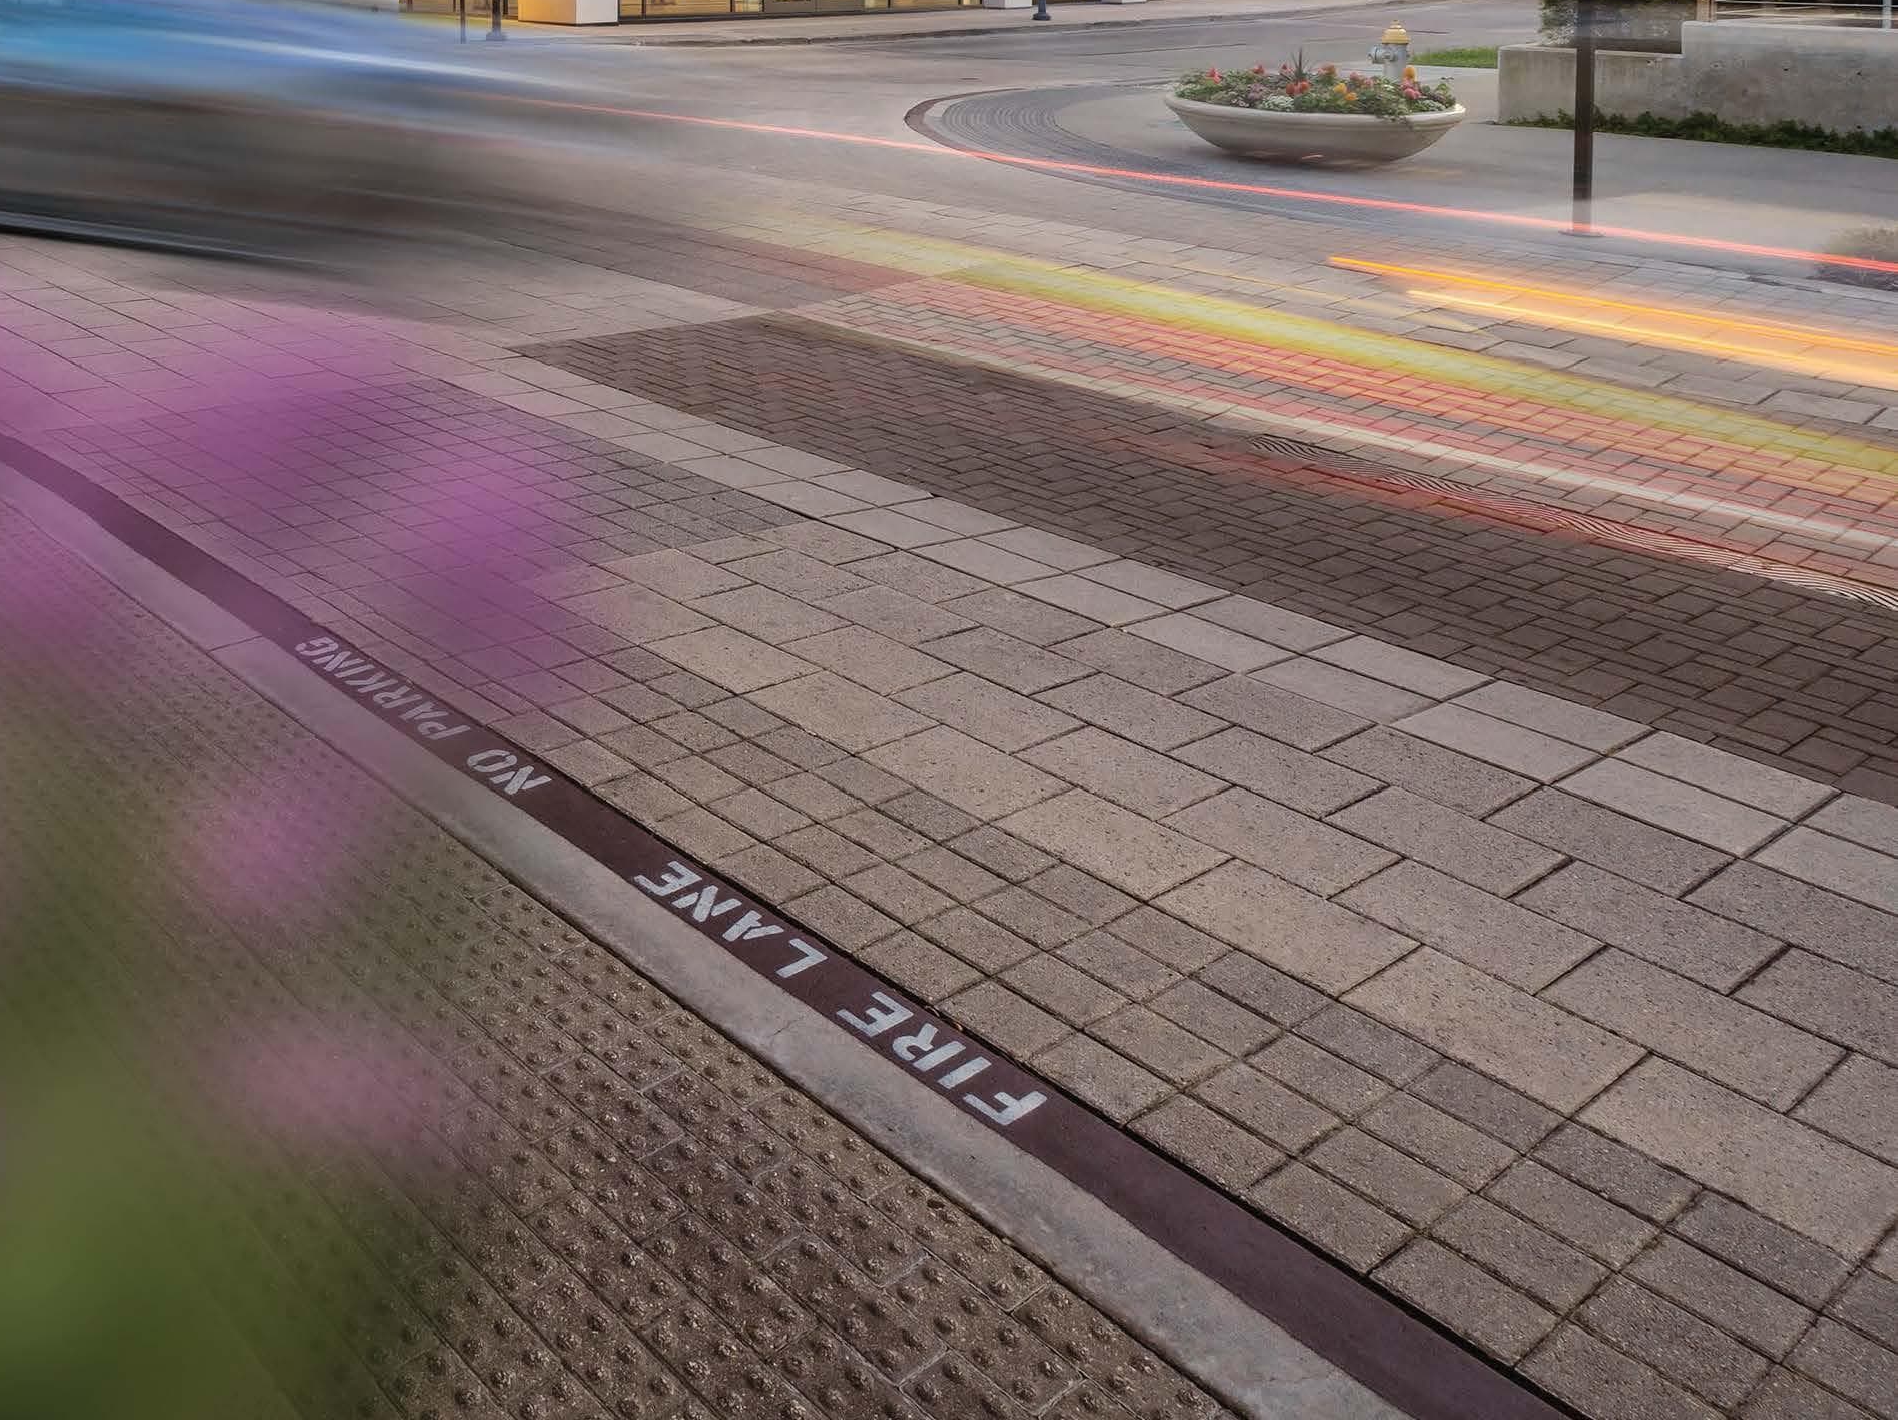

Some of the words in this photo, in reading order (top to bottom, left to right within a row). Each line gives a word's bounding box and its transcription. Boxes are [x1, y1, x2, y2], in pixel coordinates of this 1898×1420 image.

[295, 636, 471, 741] PARKING
[466, 749, 553, 796] NO
[634, 860, 829, 979] LANE
[836, 990, 1048, 1126] FIRE
